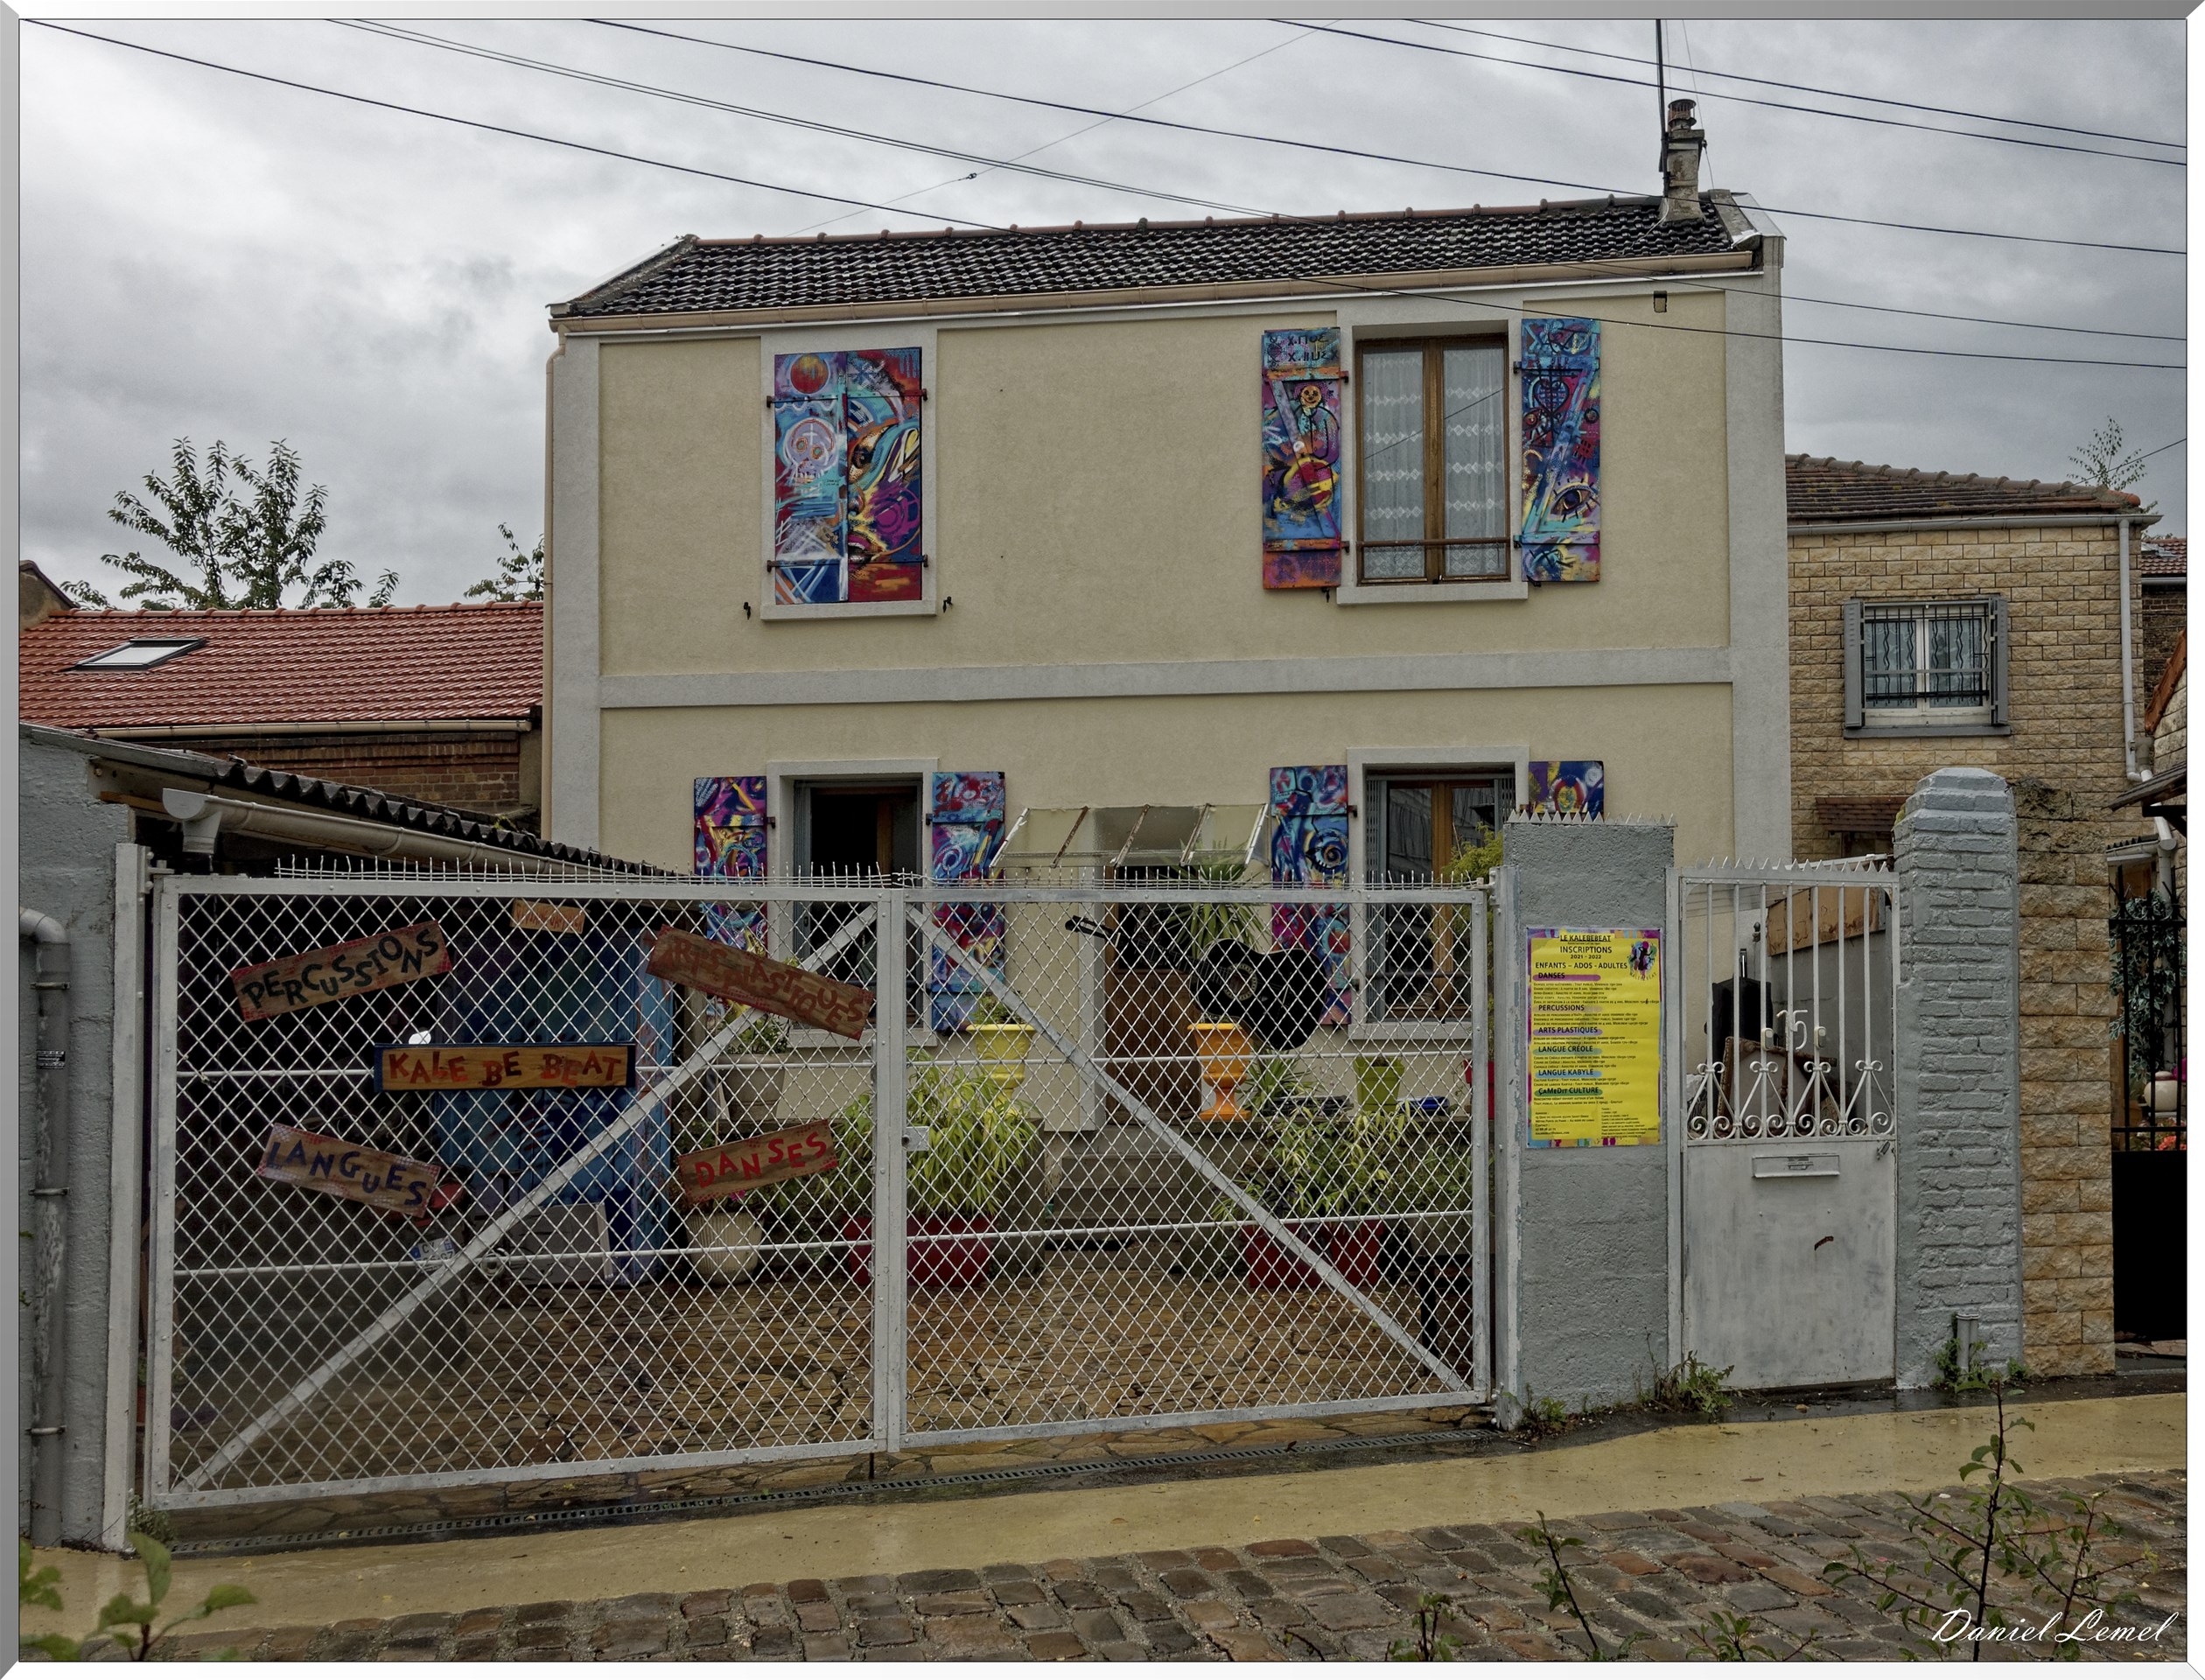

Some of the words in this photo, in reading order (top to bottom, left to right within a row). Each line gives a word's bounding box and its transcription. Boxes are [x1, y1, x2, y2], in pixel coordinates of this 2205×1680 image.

[241, 928, 439, 1009] PERCUSSIONS
[656, 938, 727, 976] ARTS
[722, 962, 864, 1028] PLASTIQUES
[1567, 1044, 1593, 1053] CRÉOLE
[1776, 1010, 1808, 1051] 15
[388, 1051, 468, 1083] KALE
[482, 1051, 522, 1086] BE
[542, 1050, 622, 1087] BEAT
[266, 1139, 427, 1206] LANGUES
[695, 1132, 827, 1187] DANSES
